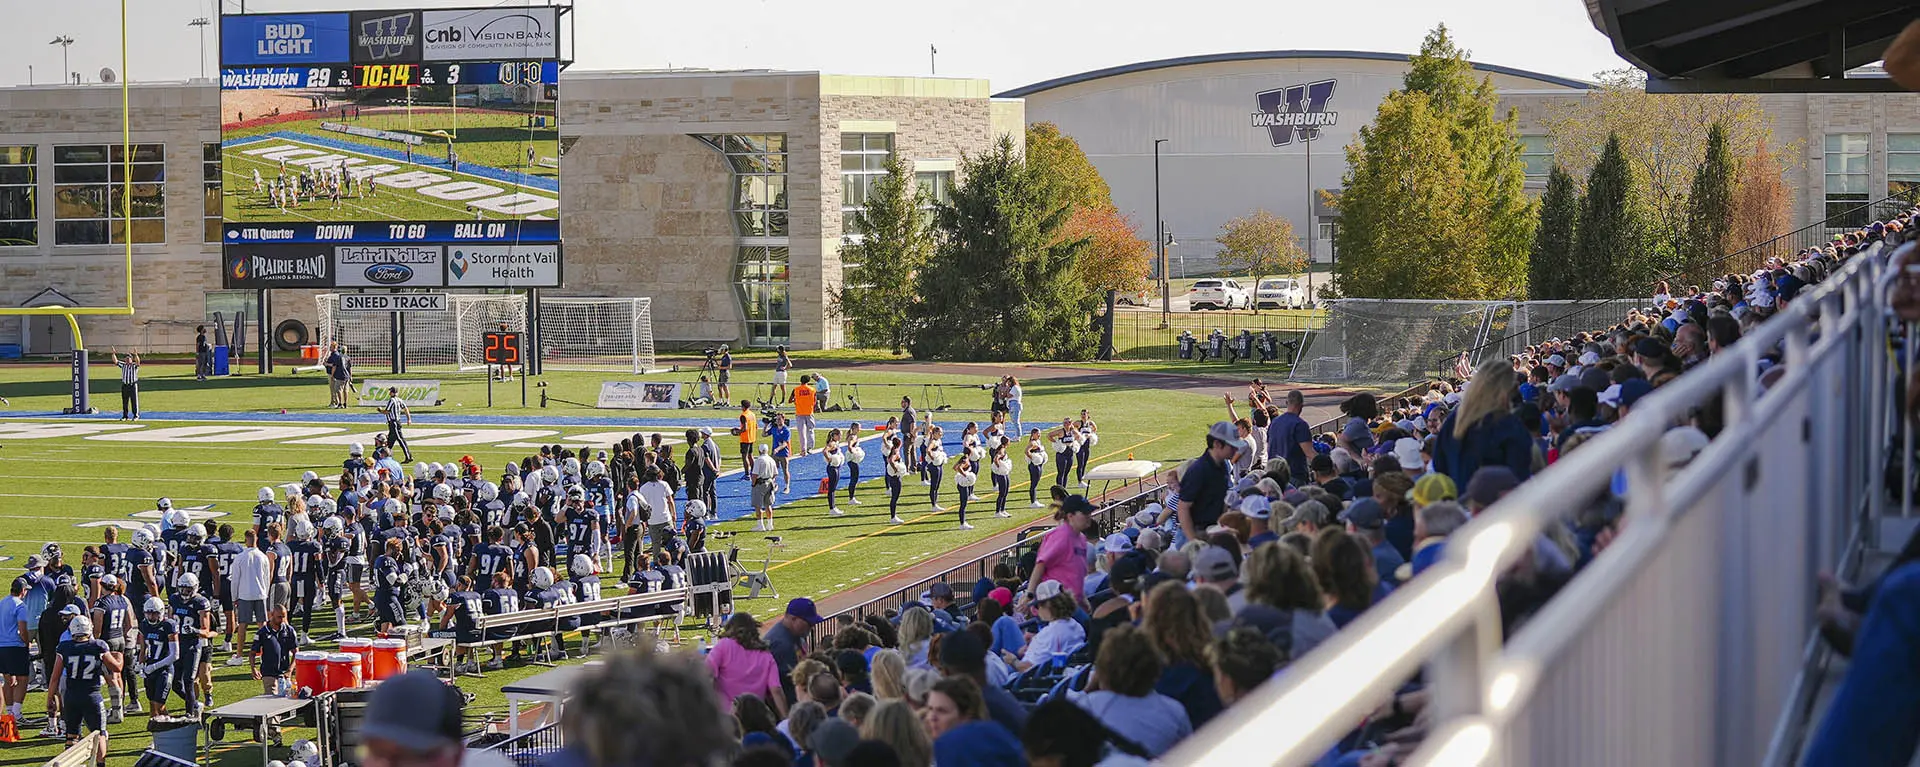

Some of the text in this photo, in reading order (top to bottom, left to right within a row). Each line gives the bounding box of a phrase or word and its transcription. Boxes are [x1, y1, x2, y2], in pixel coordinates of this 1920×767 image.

[265, 24, 305, 39] BUD
[425, 26, 461, 43] cnb
[258, 39, 312, 55] LIGHT
[359, 35, 414, 46] WASHBURN
[222, 68, 331, 87] WASHBURN 29
[341, 70, 348, 78] 3
[362, 65, 410, 86] 10:14
[424, 68, 431, 76] 2
[447, 64, 460, 84] 3
[1251, 112, 1338, 127] WASHBURN
[242, 228, 294, 240] 4TH Quarter
[316, 225, 354, 240] DOWN
[389, 224, 426, 239] TO GO
[454, 224, 506, 238] BALL ON
[472, 252, 557, 264] Stormont Vail
[252, 254, 326, 278] PRAIRIE BAND
[375, 267, 402, 280] Ford
[492, 266, 534, 278] Health
[346, 296, 439, 308] SNEED TRACK
[486, 334, 517, 362] 25
[362, 386, 438, 400] SUWAY
[569, 523, 588, 540] 97
[293, 552, 309, 572] 11
[481, 554, 500, 575] 91
[68, 656, 96, 680] 72
